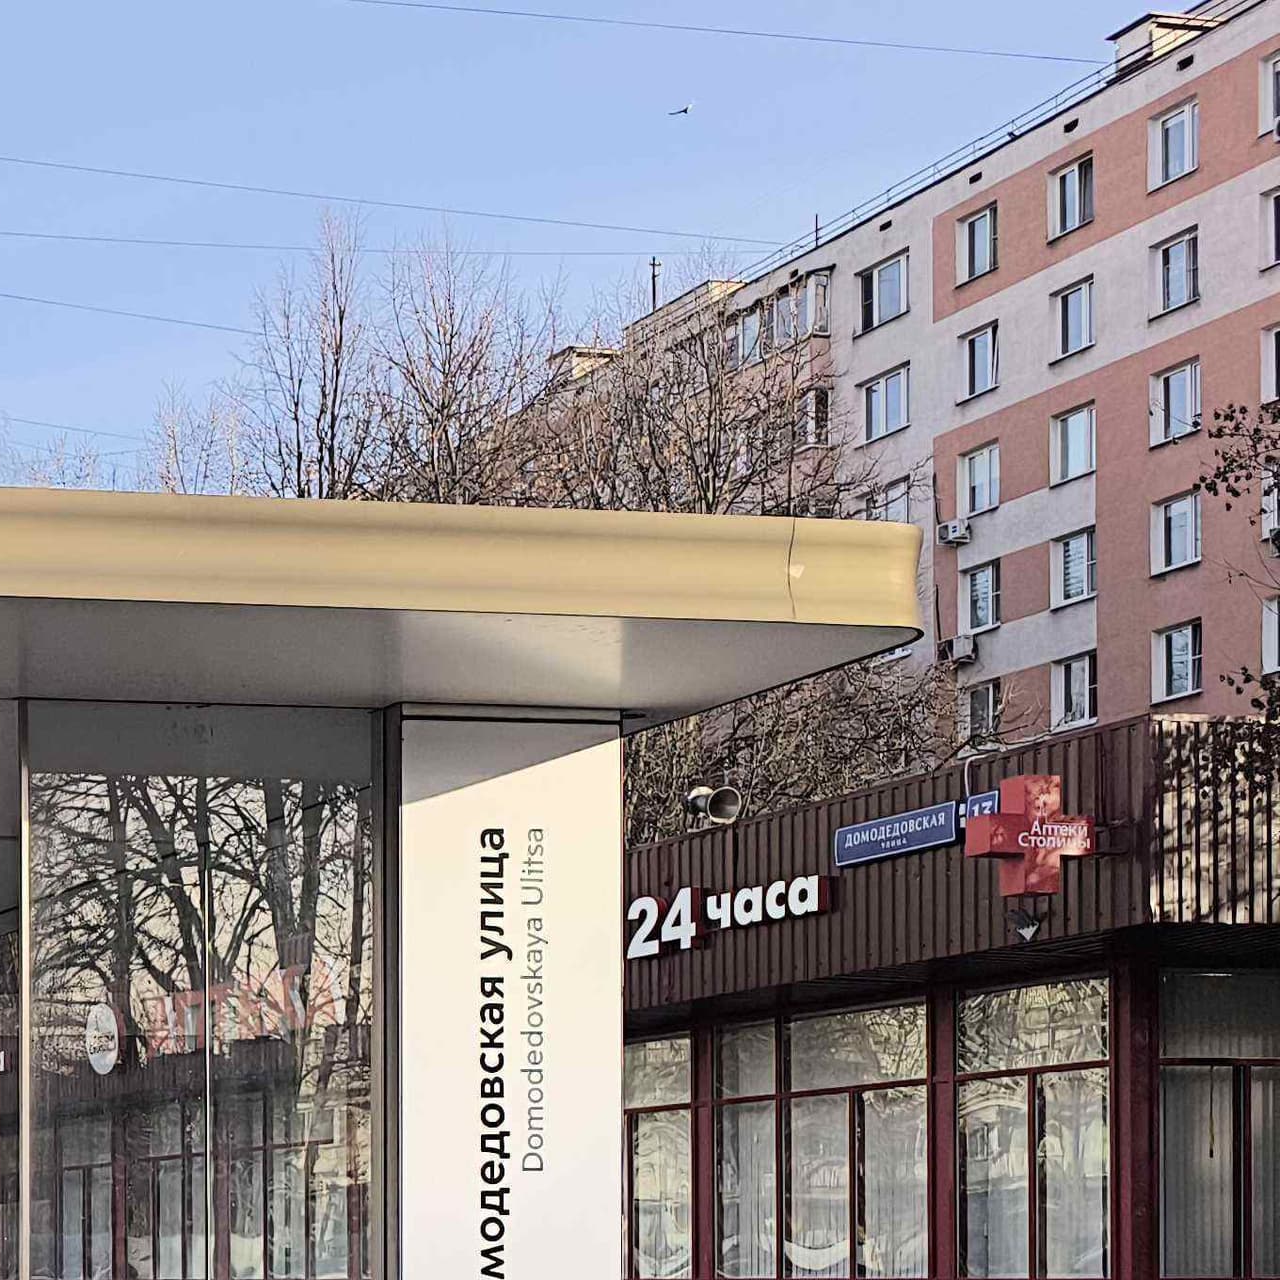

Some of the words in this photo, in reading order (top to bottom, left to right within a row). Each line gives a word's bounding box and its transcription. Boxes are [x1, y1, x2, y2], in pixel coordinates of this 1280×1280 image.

[520, 826, 545, 906] Ulitsa
[844, 811, 946, 849] ДОМОДЕДОВСКАЯ
[1030, 820, 1088, 837] Аптеки
[479, 826, 513, 961] улица
[626, 886, 697, 960] 24
[706, 874, 820, 929] часа
[520, 916, 549, 1173] Domodedovskaya
